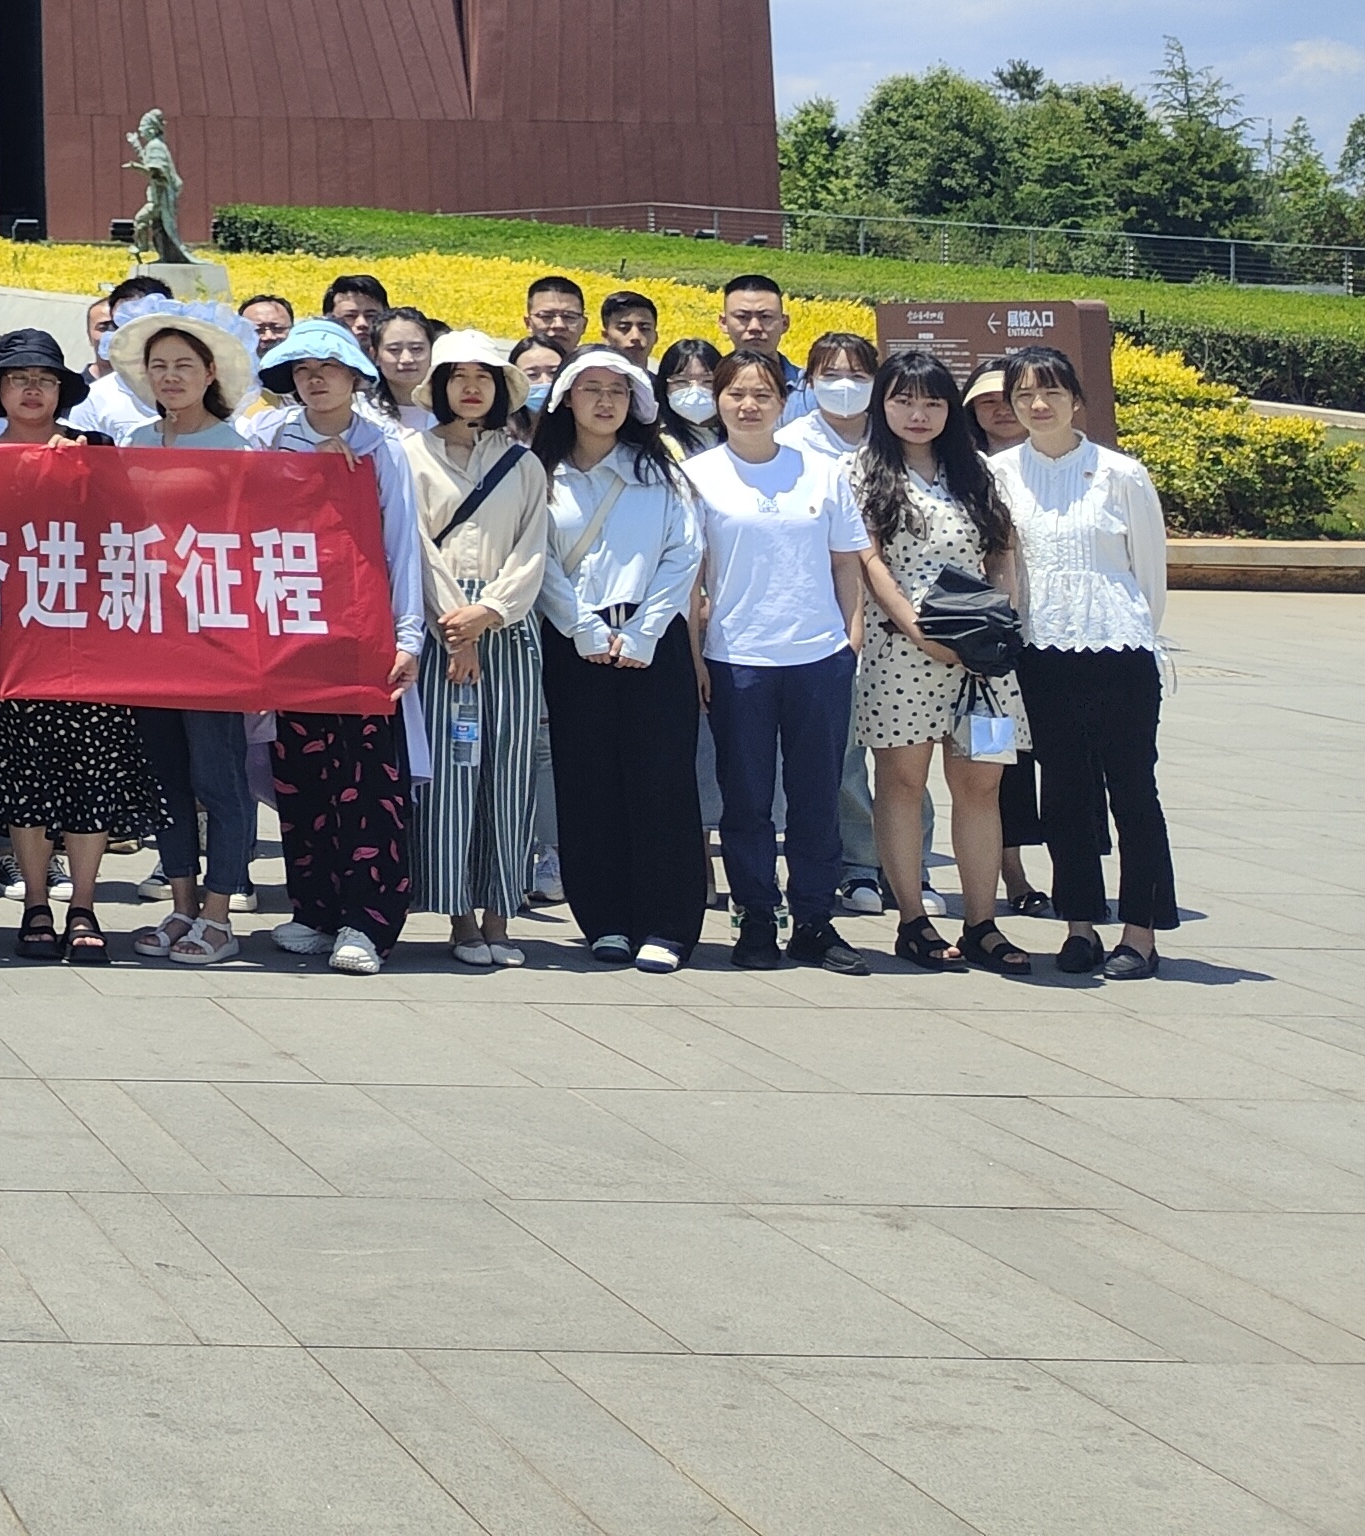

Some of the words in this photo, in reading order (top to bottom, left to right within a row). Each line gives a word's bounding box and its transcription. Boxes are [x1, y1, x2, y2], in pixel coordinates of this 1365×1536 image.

[1007, 310, 1054, 327] 展馆入口
[1007, 327, 1044, 337] ENTRANCE
